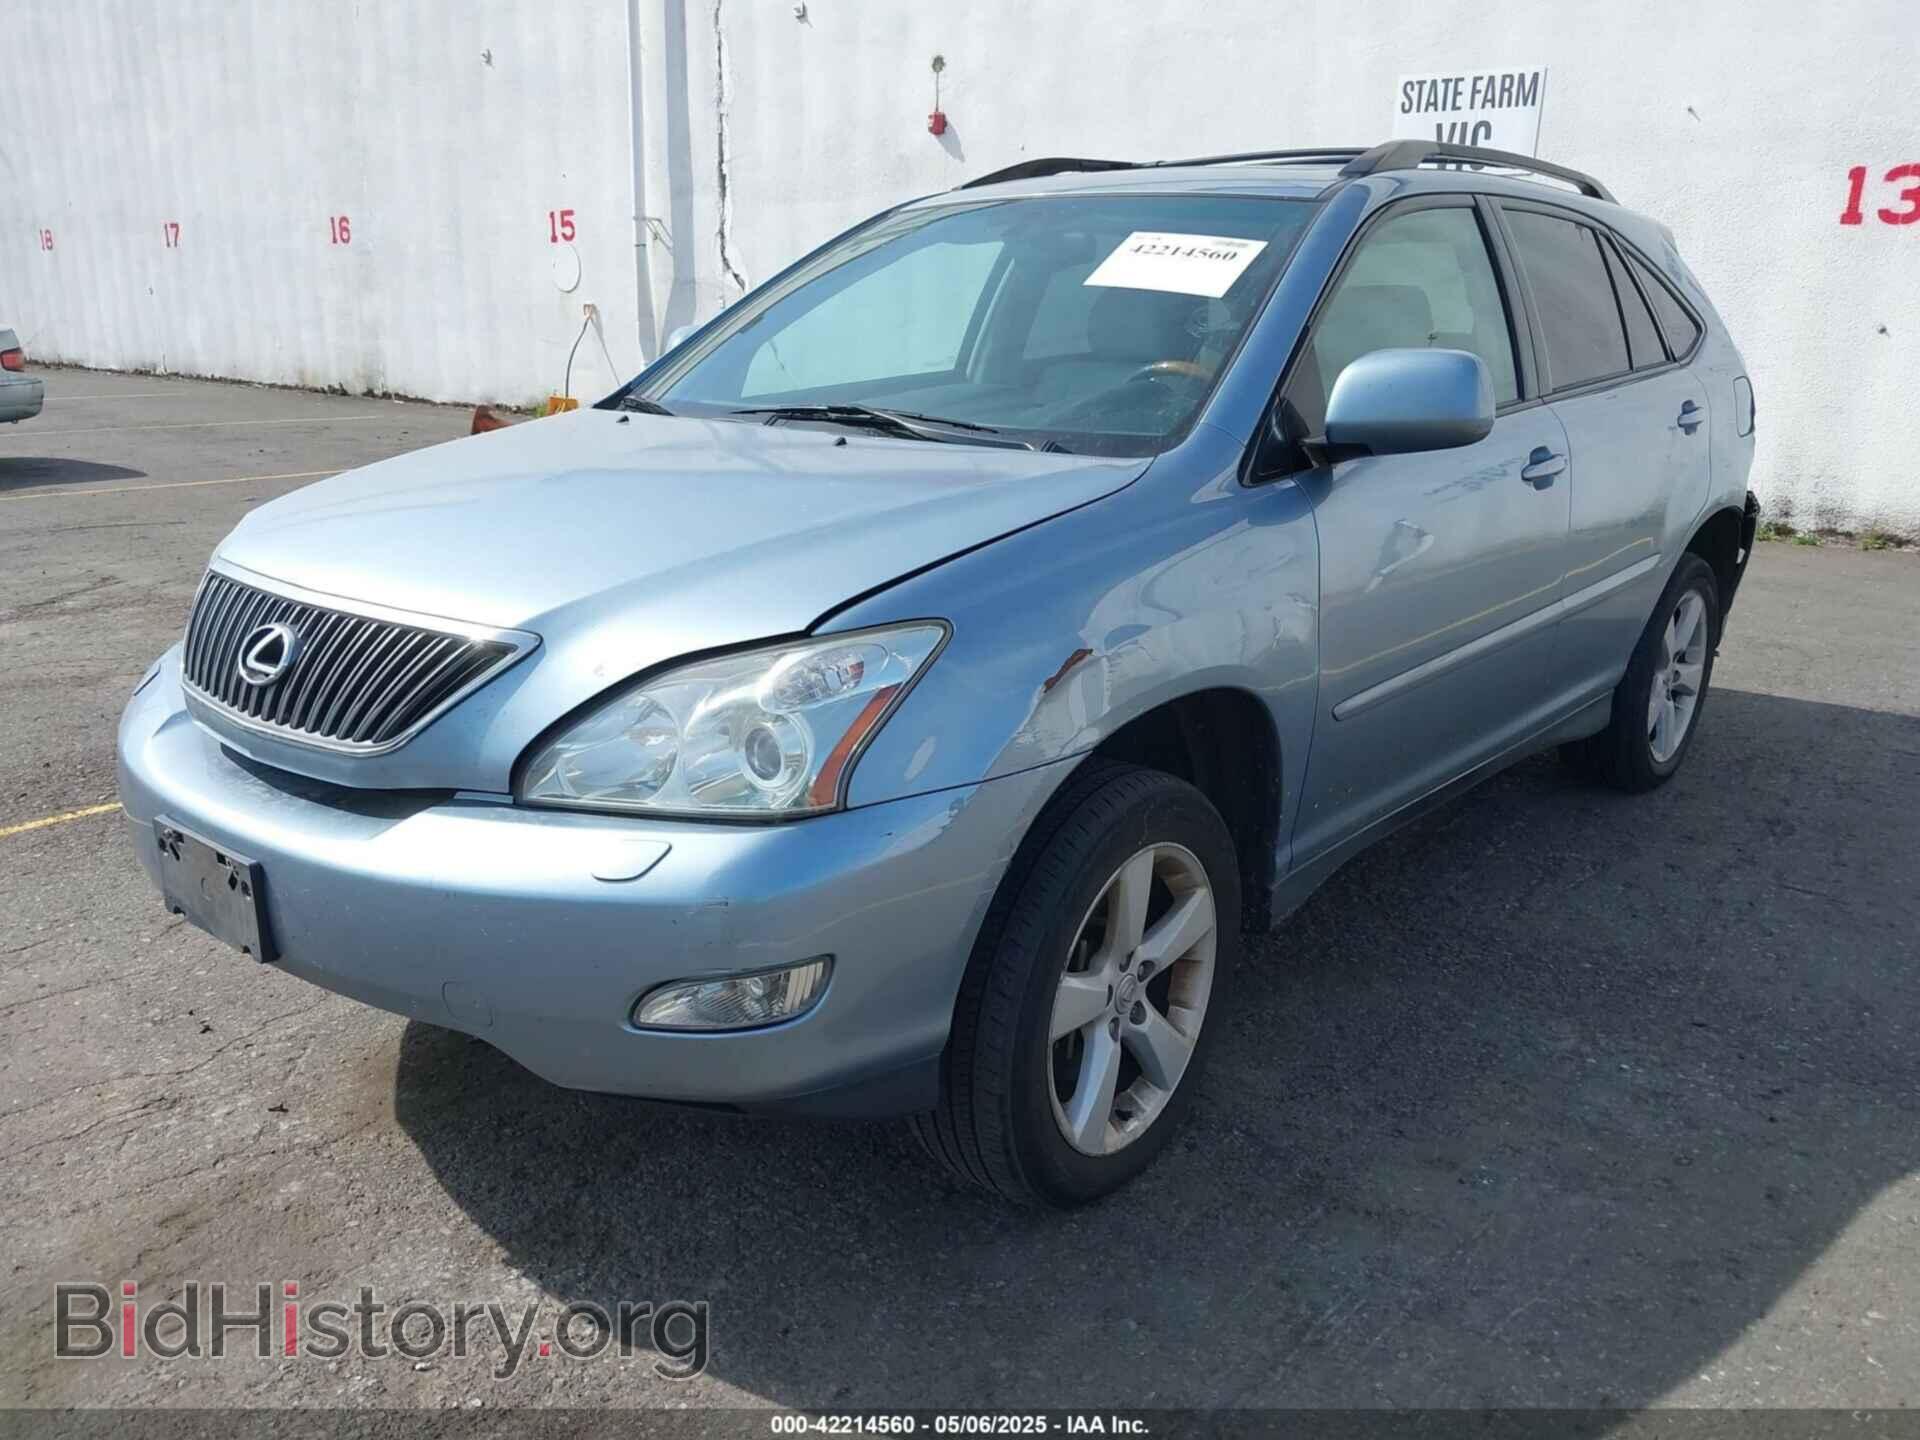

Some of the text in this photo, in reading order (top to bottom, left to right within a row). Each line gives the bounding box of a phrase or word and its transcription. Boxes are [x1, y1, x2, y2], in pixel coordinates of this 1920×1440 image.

[1401, 71, 1540, 114] STATE FARM
[1839, 163, 1920, 225] 13
[39, 228, 54, 252] 18
[163, 222, 180, 249] 17
[330, 215, 351, 245] 16
[548, 208, 577, 244] 15
[1130, 243, 1239, 262] 42214560
